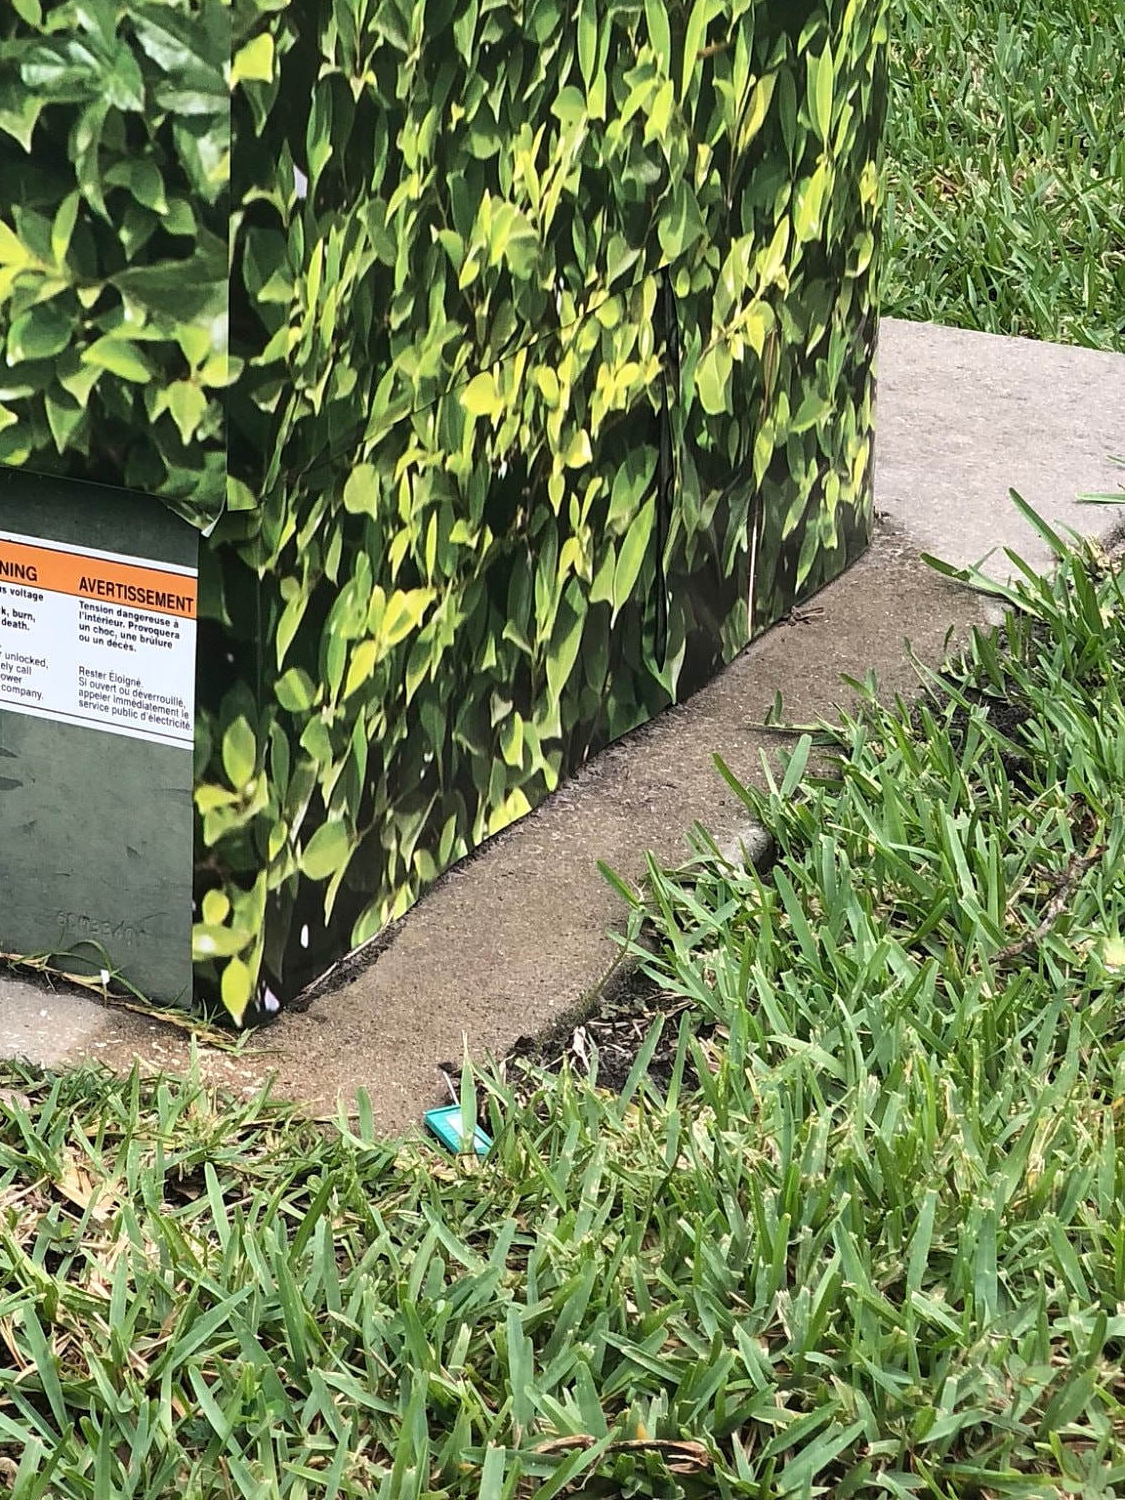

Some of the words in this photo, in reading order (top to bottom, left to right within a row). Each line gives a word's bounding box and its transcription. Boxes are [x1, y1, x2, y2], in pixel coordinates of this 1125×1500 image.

[10, 588, 43, 602] voltage
[79, 577, 193, 612] AVERTISSEMENT
[12, 608, 35, 622] burn,
[79, 600, 114, 615] Tension
[117, 608, 170, 627] dangereuse
[174, 619, 179, 628] à
[1, 617, 30, 631] death.
[79, 611, 125, 628] l'intérieur.
[128, 621, 180, 639] Provoquera
[79, 624, 90, 632] un
[93, 626, 117, 639] choc,
[120, 632, 137, 641] une
[93, 637, 104, 645] un
[5, 653, 48, 669] unlocked,
[16, 666, 31, 675] call
[79, 666, 107, 680] Rester
[1, 684, 43, 701] company.
[79, 677, 87, 686] Si
[90, 681, 116, 693] ouvert
[119, 687, 129, 695] ou
[79, 689, 110, 701] appeler
[113, 695, 178, 717] immédiatement
[182, 709, 189, 719] le
[79, 700, 109, 712] service
[112, 707, 138, 719] public
